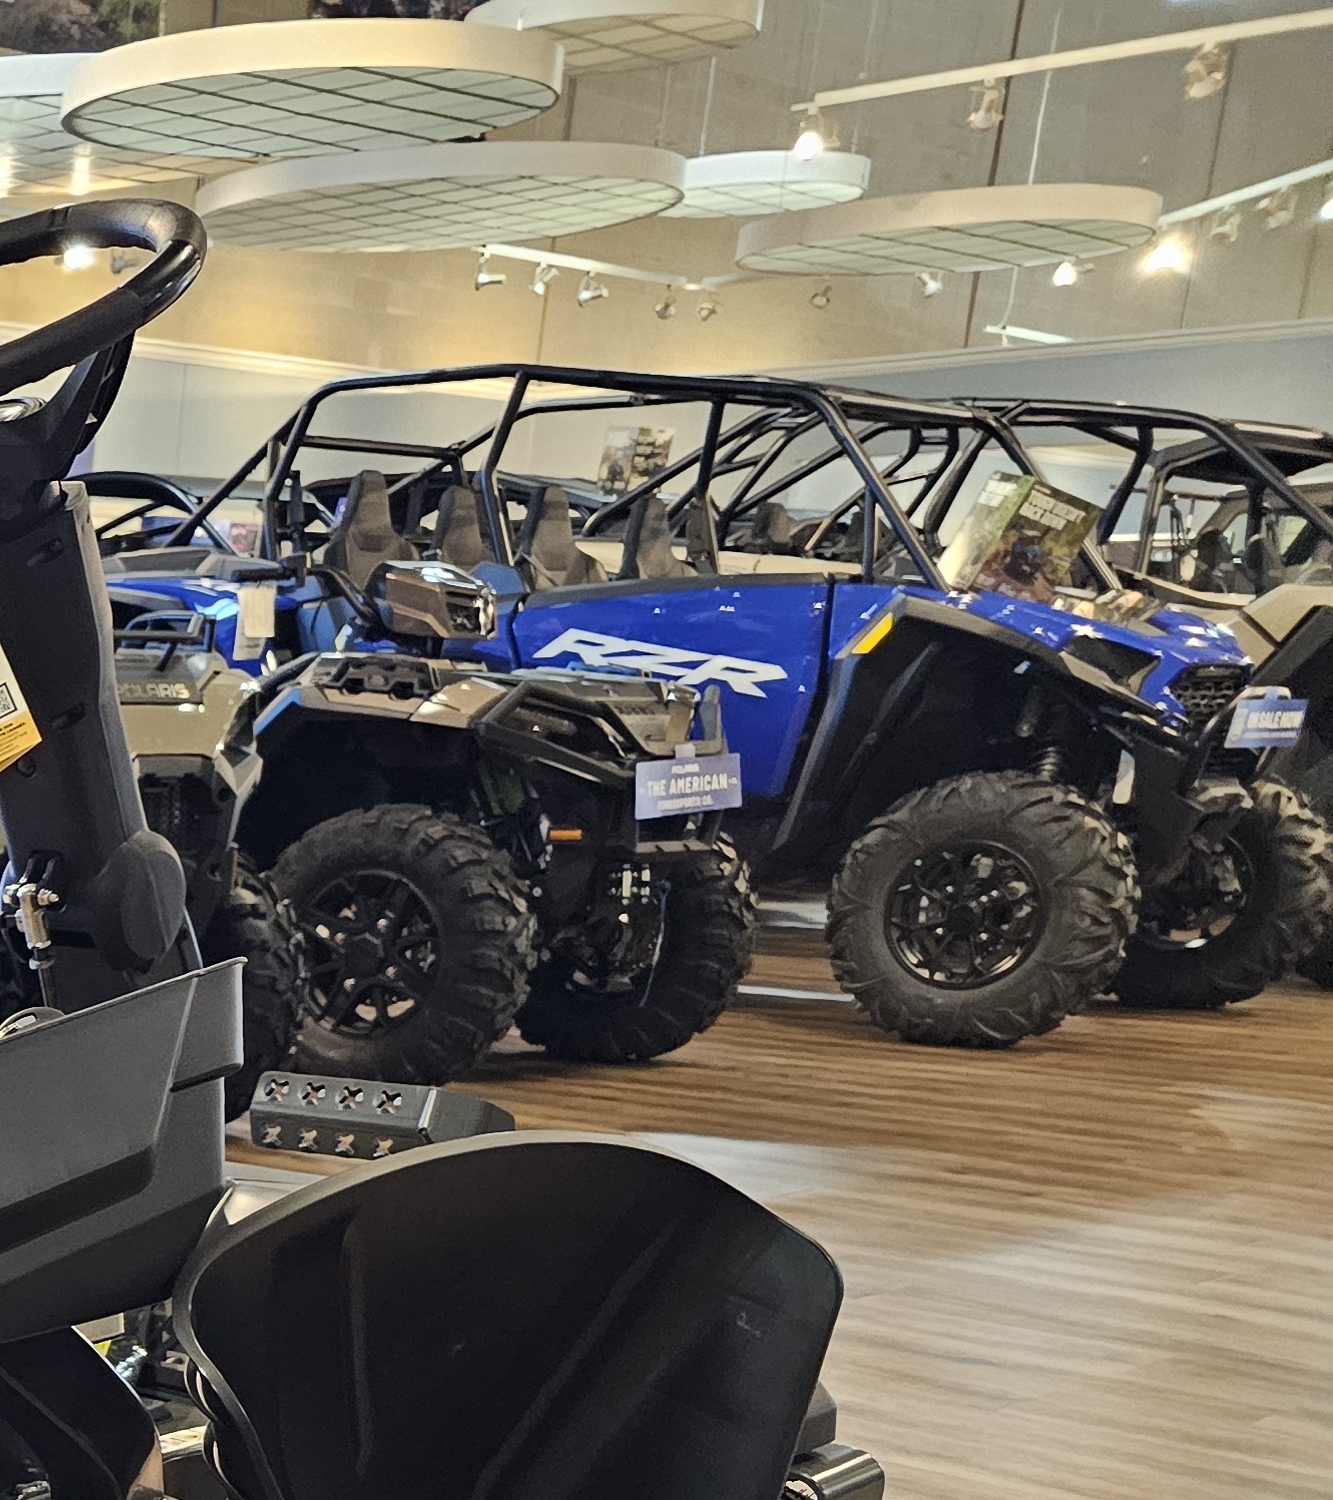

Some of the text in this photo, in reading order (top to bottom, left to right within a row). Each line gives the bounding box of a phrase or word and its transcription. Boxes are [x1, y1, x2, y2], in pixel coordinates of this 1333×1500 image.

[532, 627, 789, 699] RZR
[646, 772, 728, 797] THE AMERICAN
